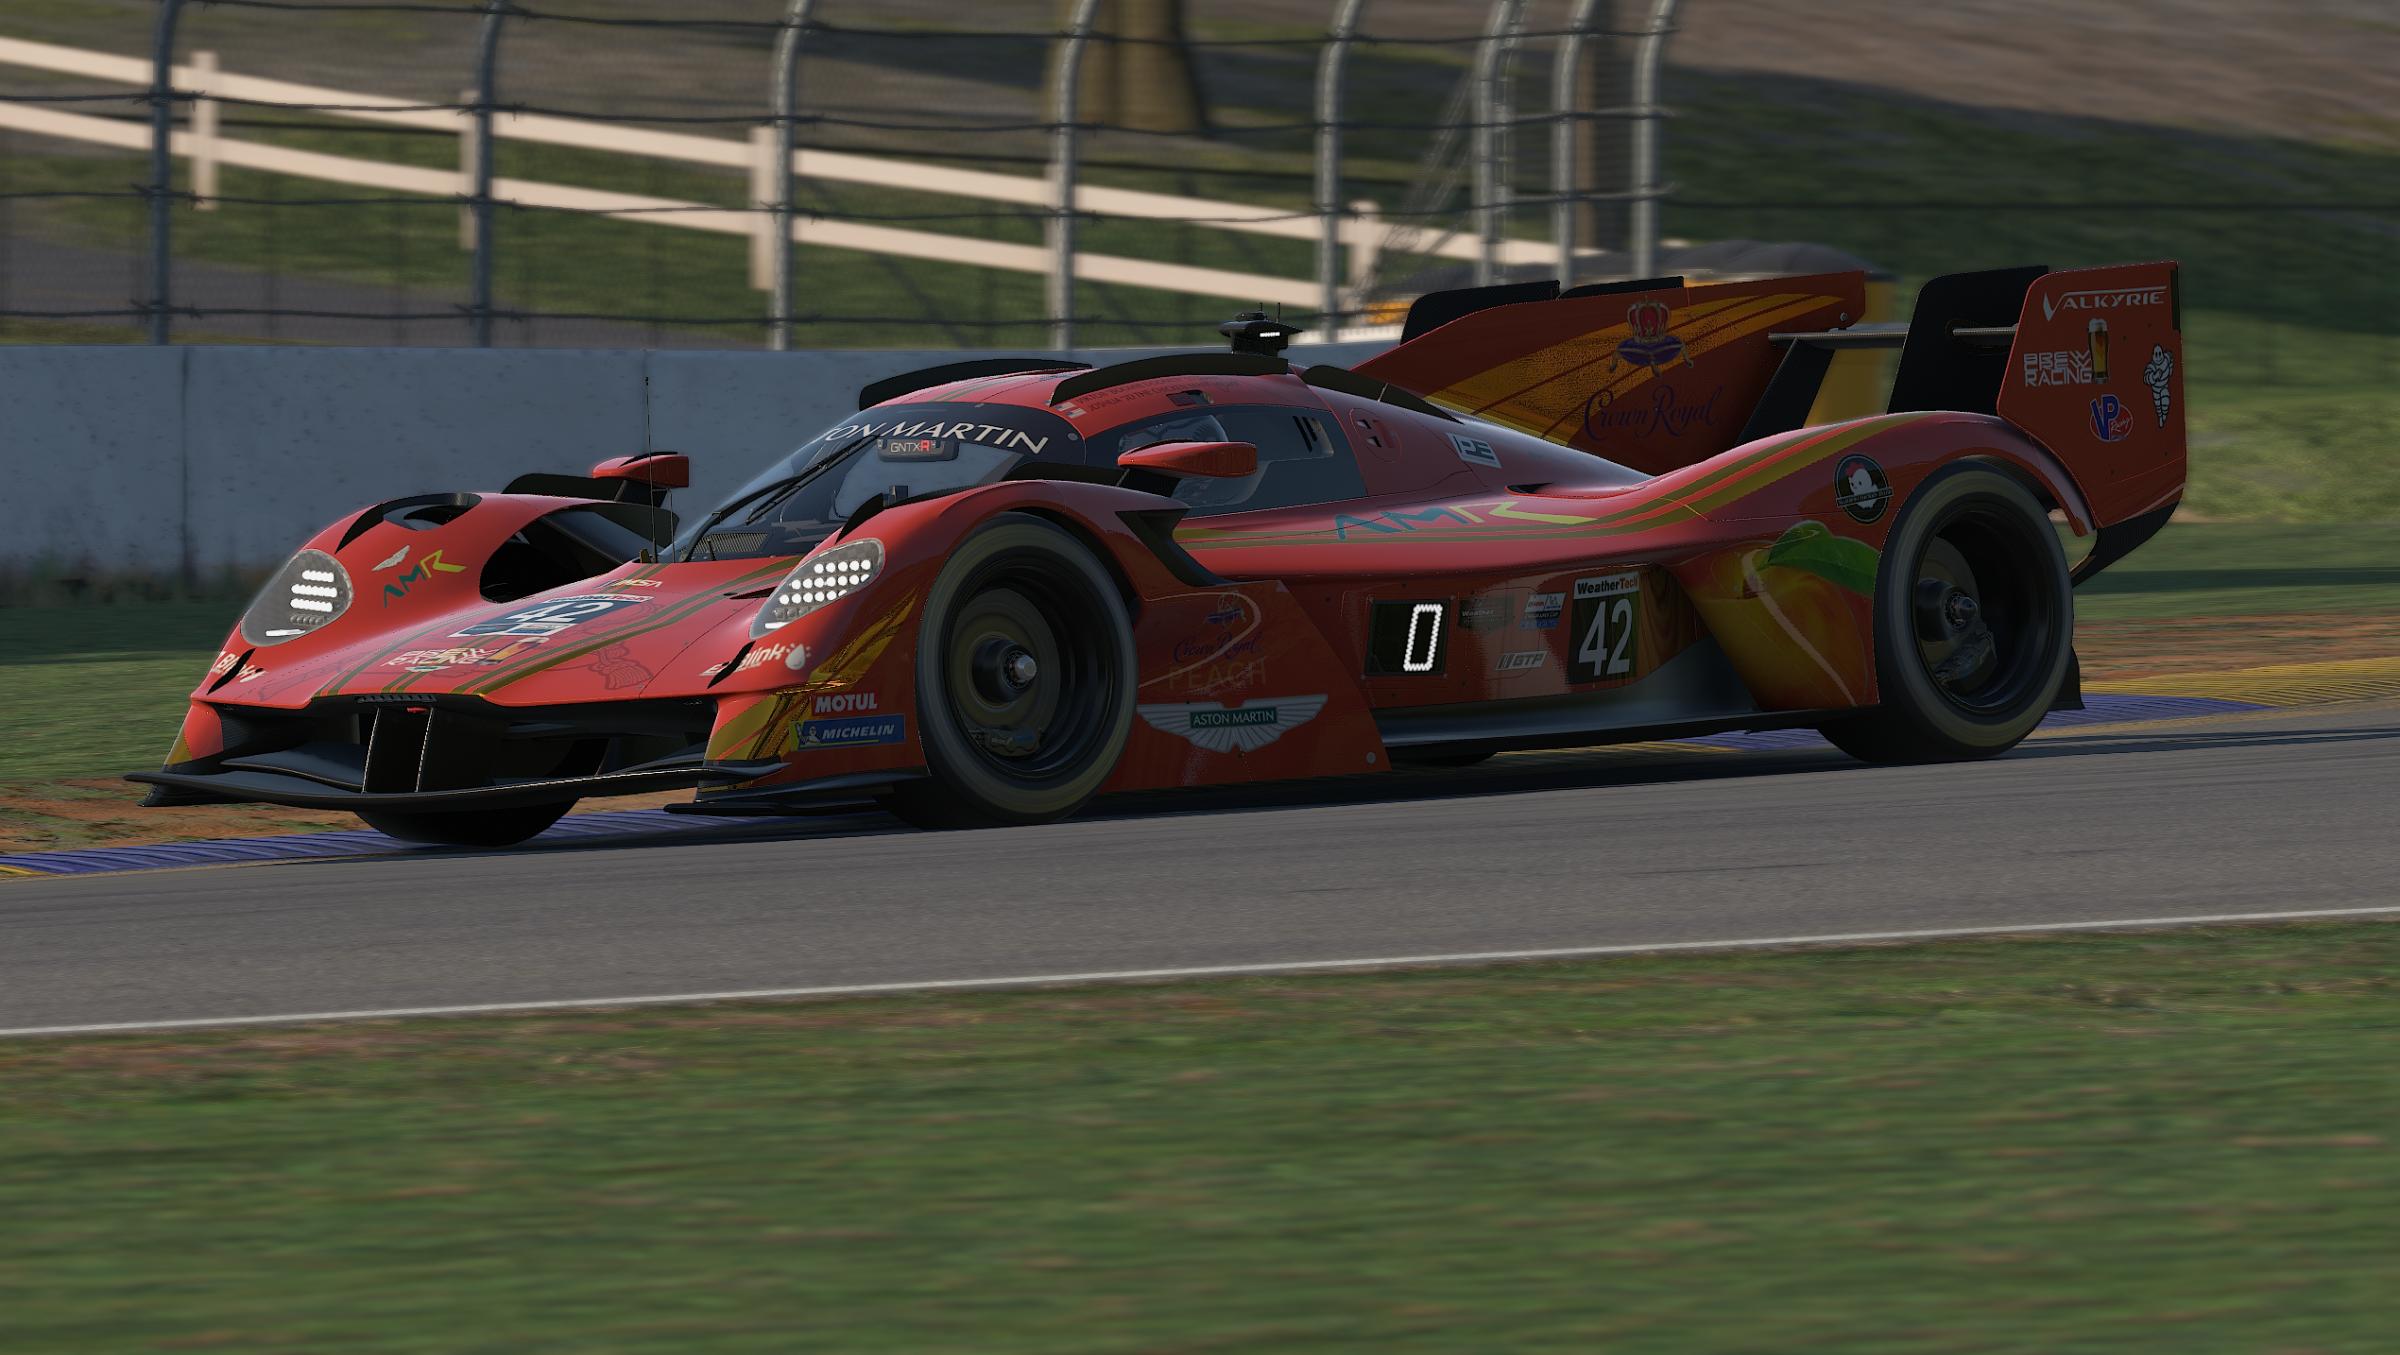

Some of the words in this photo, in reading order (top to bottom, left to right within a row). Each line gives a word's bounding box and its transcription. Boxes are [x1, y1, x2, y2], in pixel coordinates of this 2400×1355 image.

[2043, 285, 2167, 322] VALKYRIE
[2023, 350, 2092, 370] BREW
[2024, 368, 2092, 388] RACING
[1583, 388, 1649, 441] Crown
[1633, 384, 1722, 440] Royal
[2090, 393, 2121, 442] VP
[879, 420, 1047, 455] MARTIN
[384, 549, 467, 609] AMR
[504, 601, 615, 623] 42
[1403, 603, 1444, 672] 0
[1579, 598, 1633, 676] 42
[1168, 657, 1266, 690] PEACH
[1512, 652, 1545, 668] GTP
[815, 692, 878, 714] MOTUL
[1192, 711, 1231, 727] ASTON
[1231, 709, 1274, 724] MARTIN
[821, 724, 896, 740] MICHELIN
